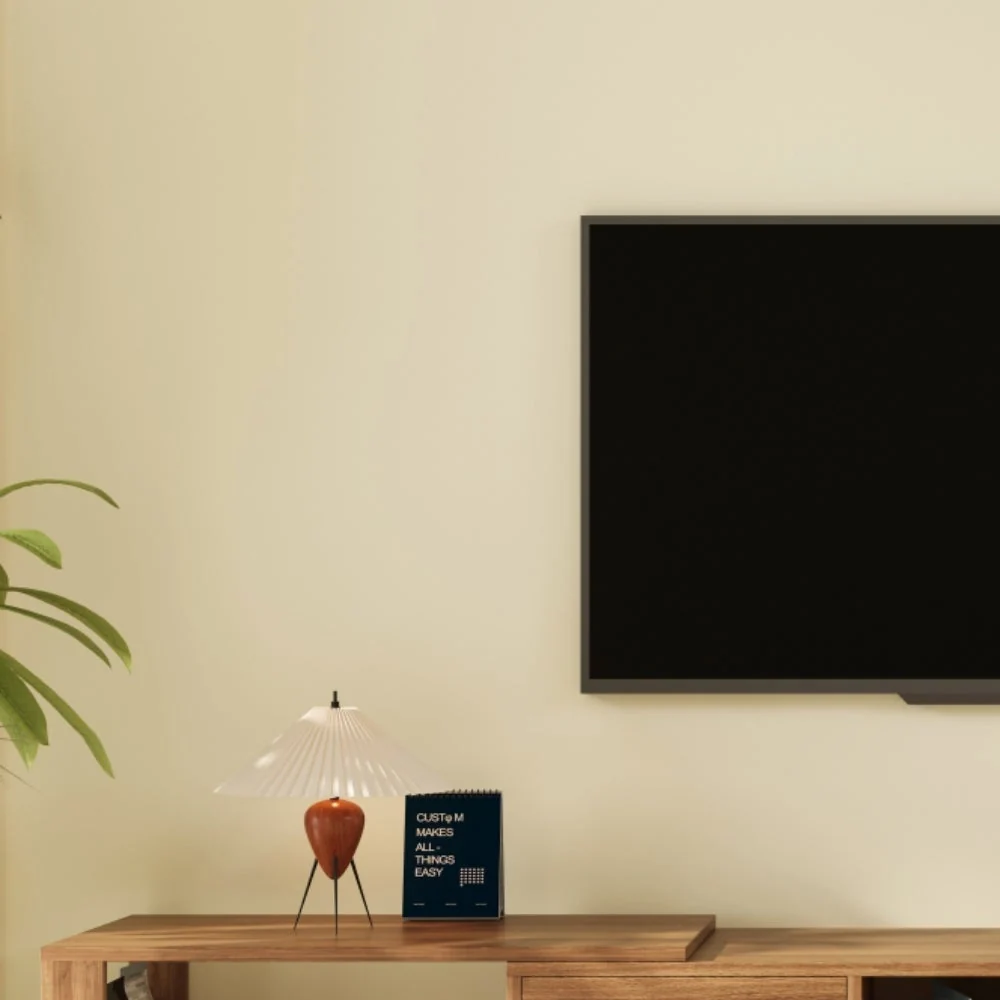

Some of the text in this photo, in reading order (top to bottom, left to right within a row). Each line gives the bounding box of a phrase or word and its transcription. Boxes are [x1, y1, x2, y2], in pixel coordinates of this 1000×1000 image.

[416, 828, 454, 837] MAKES
[415, 855, 455, 865] THINGS
[415, 867, 444, 877] EASY
